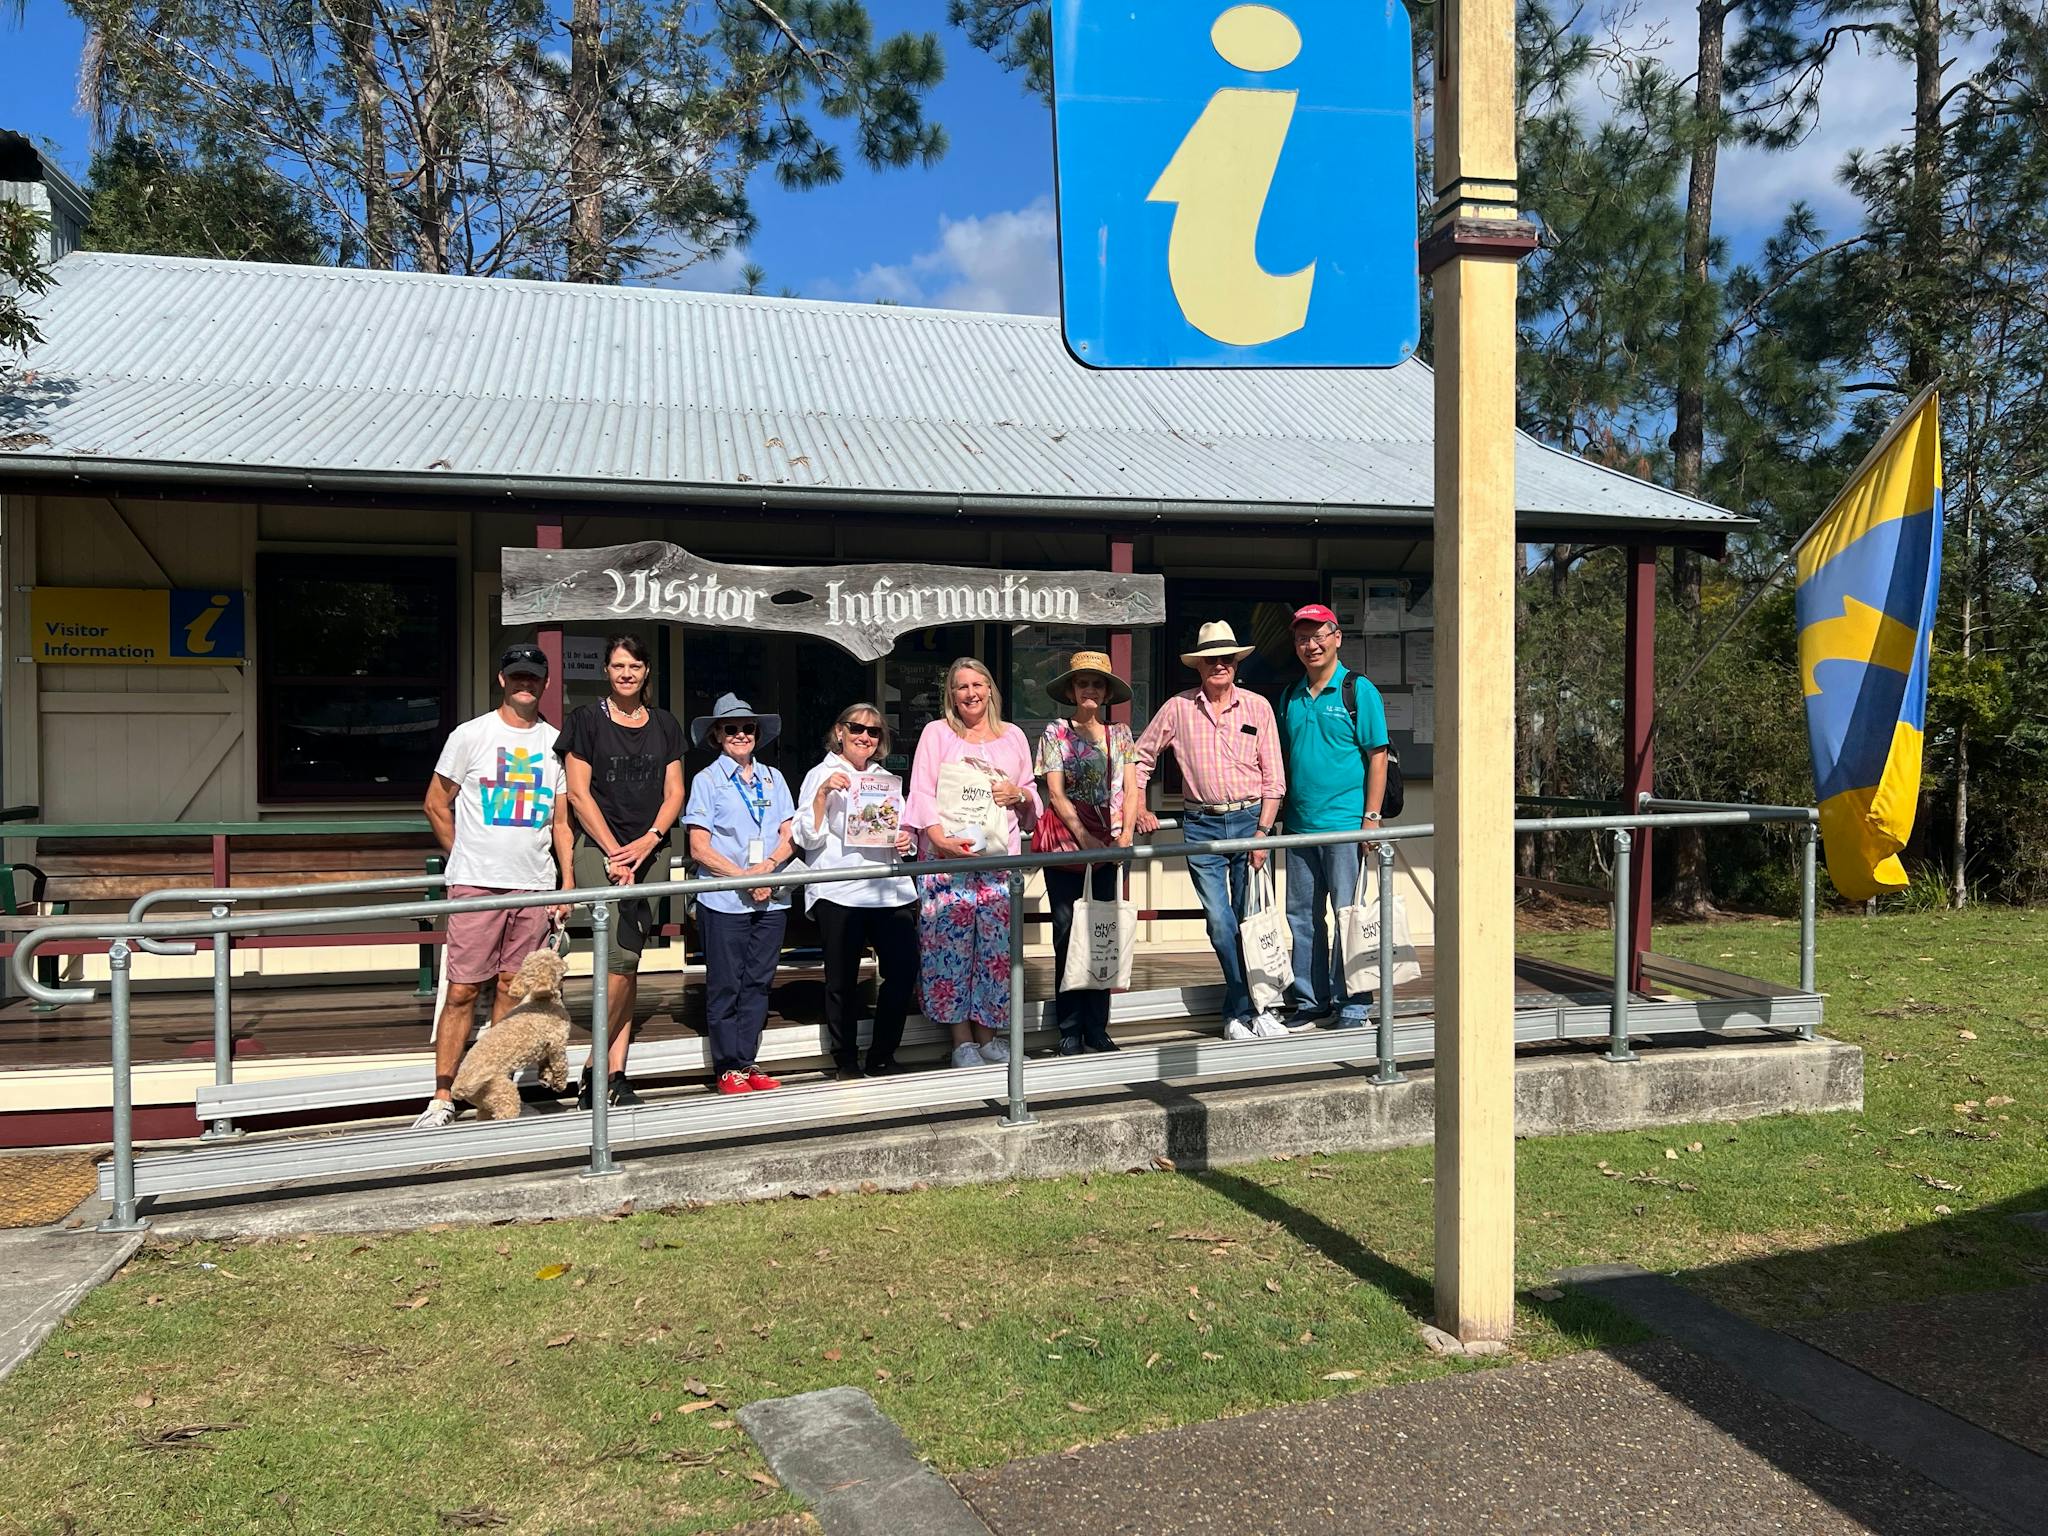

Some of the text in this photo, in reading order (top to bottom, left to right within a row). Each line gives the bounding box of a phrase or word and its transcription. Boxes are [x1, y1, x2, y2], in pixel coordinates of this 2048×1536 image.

[602, 566, 1081, 627] Visitor Information
[45, 622, 109, 637] Visitor
[44, 641, 155, 658] Information
[961, 793, 976, 801] ON
